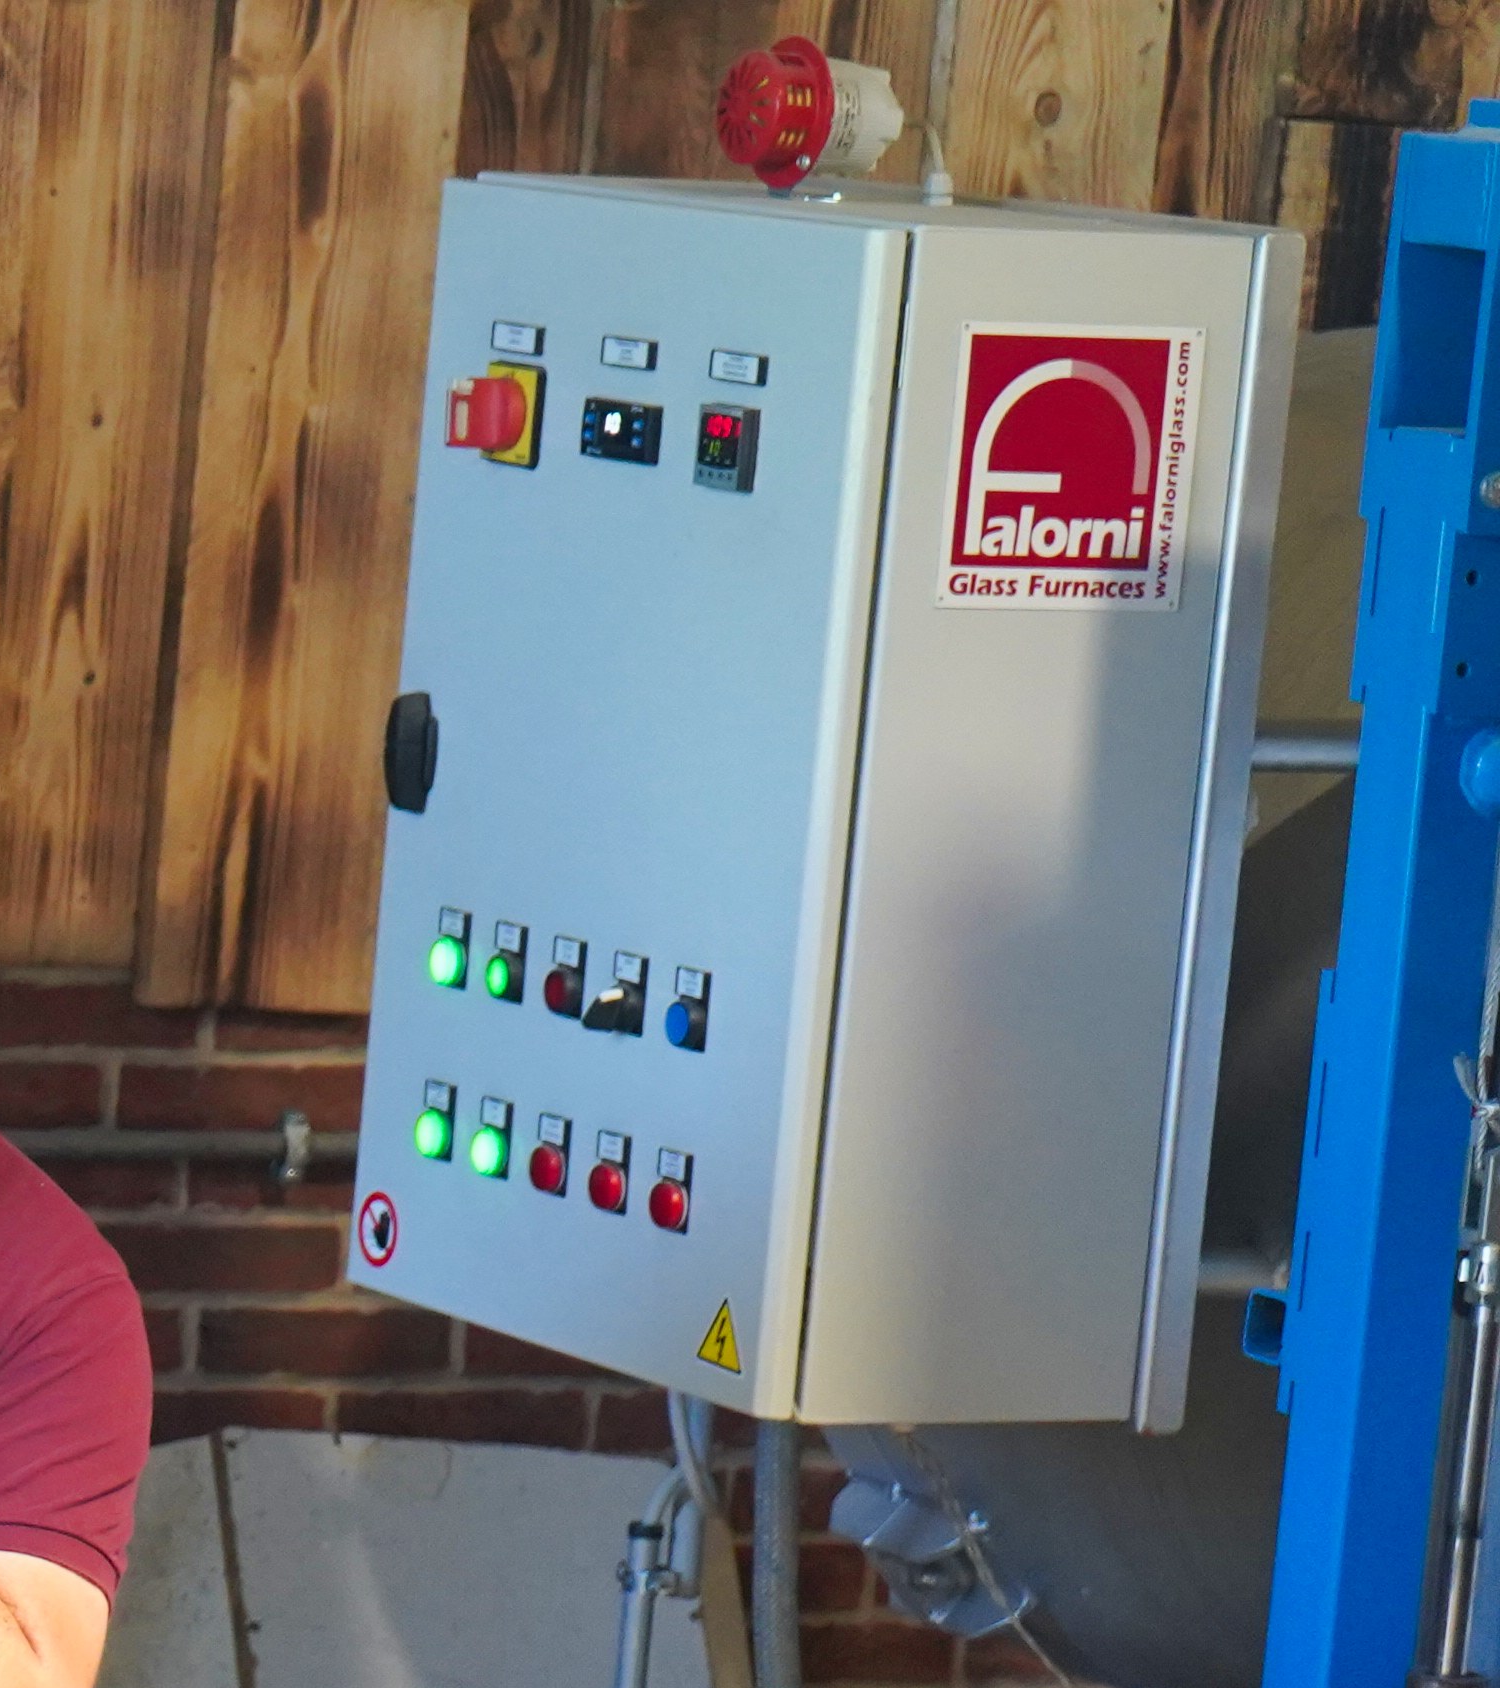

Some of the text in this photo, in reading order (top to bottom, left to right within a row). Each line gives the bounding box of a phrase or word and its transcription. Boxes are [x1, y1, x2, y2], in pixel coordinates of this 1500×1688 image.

[1155, 342, 1190, 599] www.falorniglass.com
[949, 573, 1146, 599] Glass Furnaces
